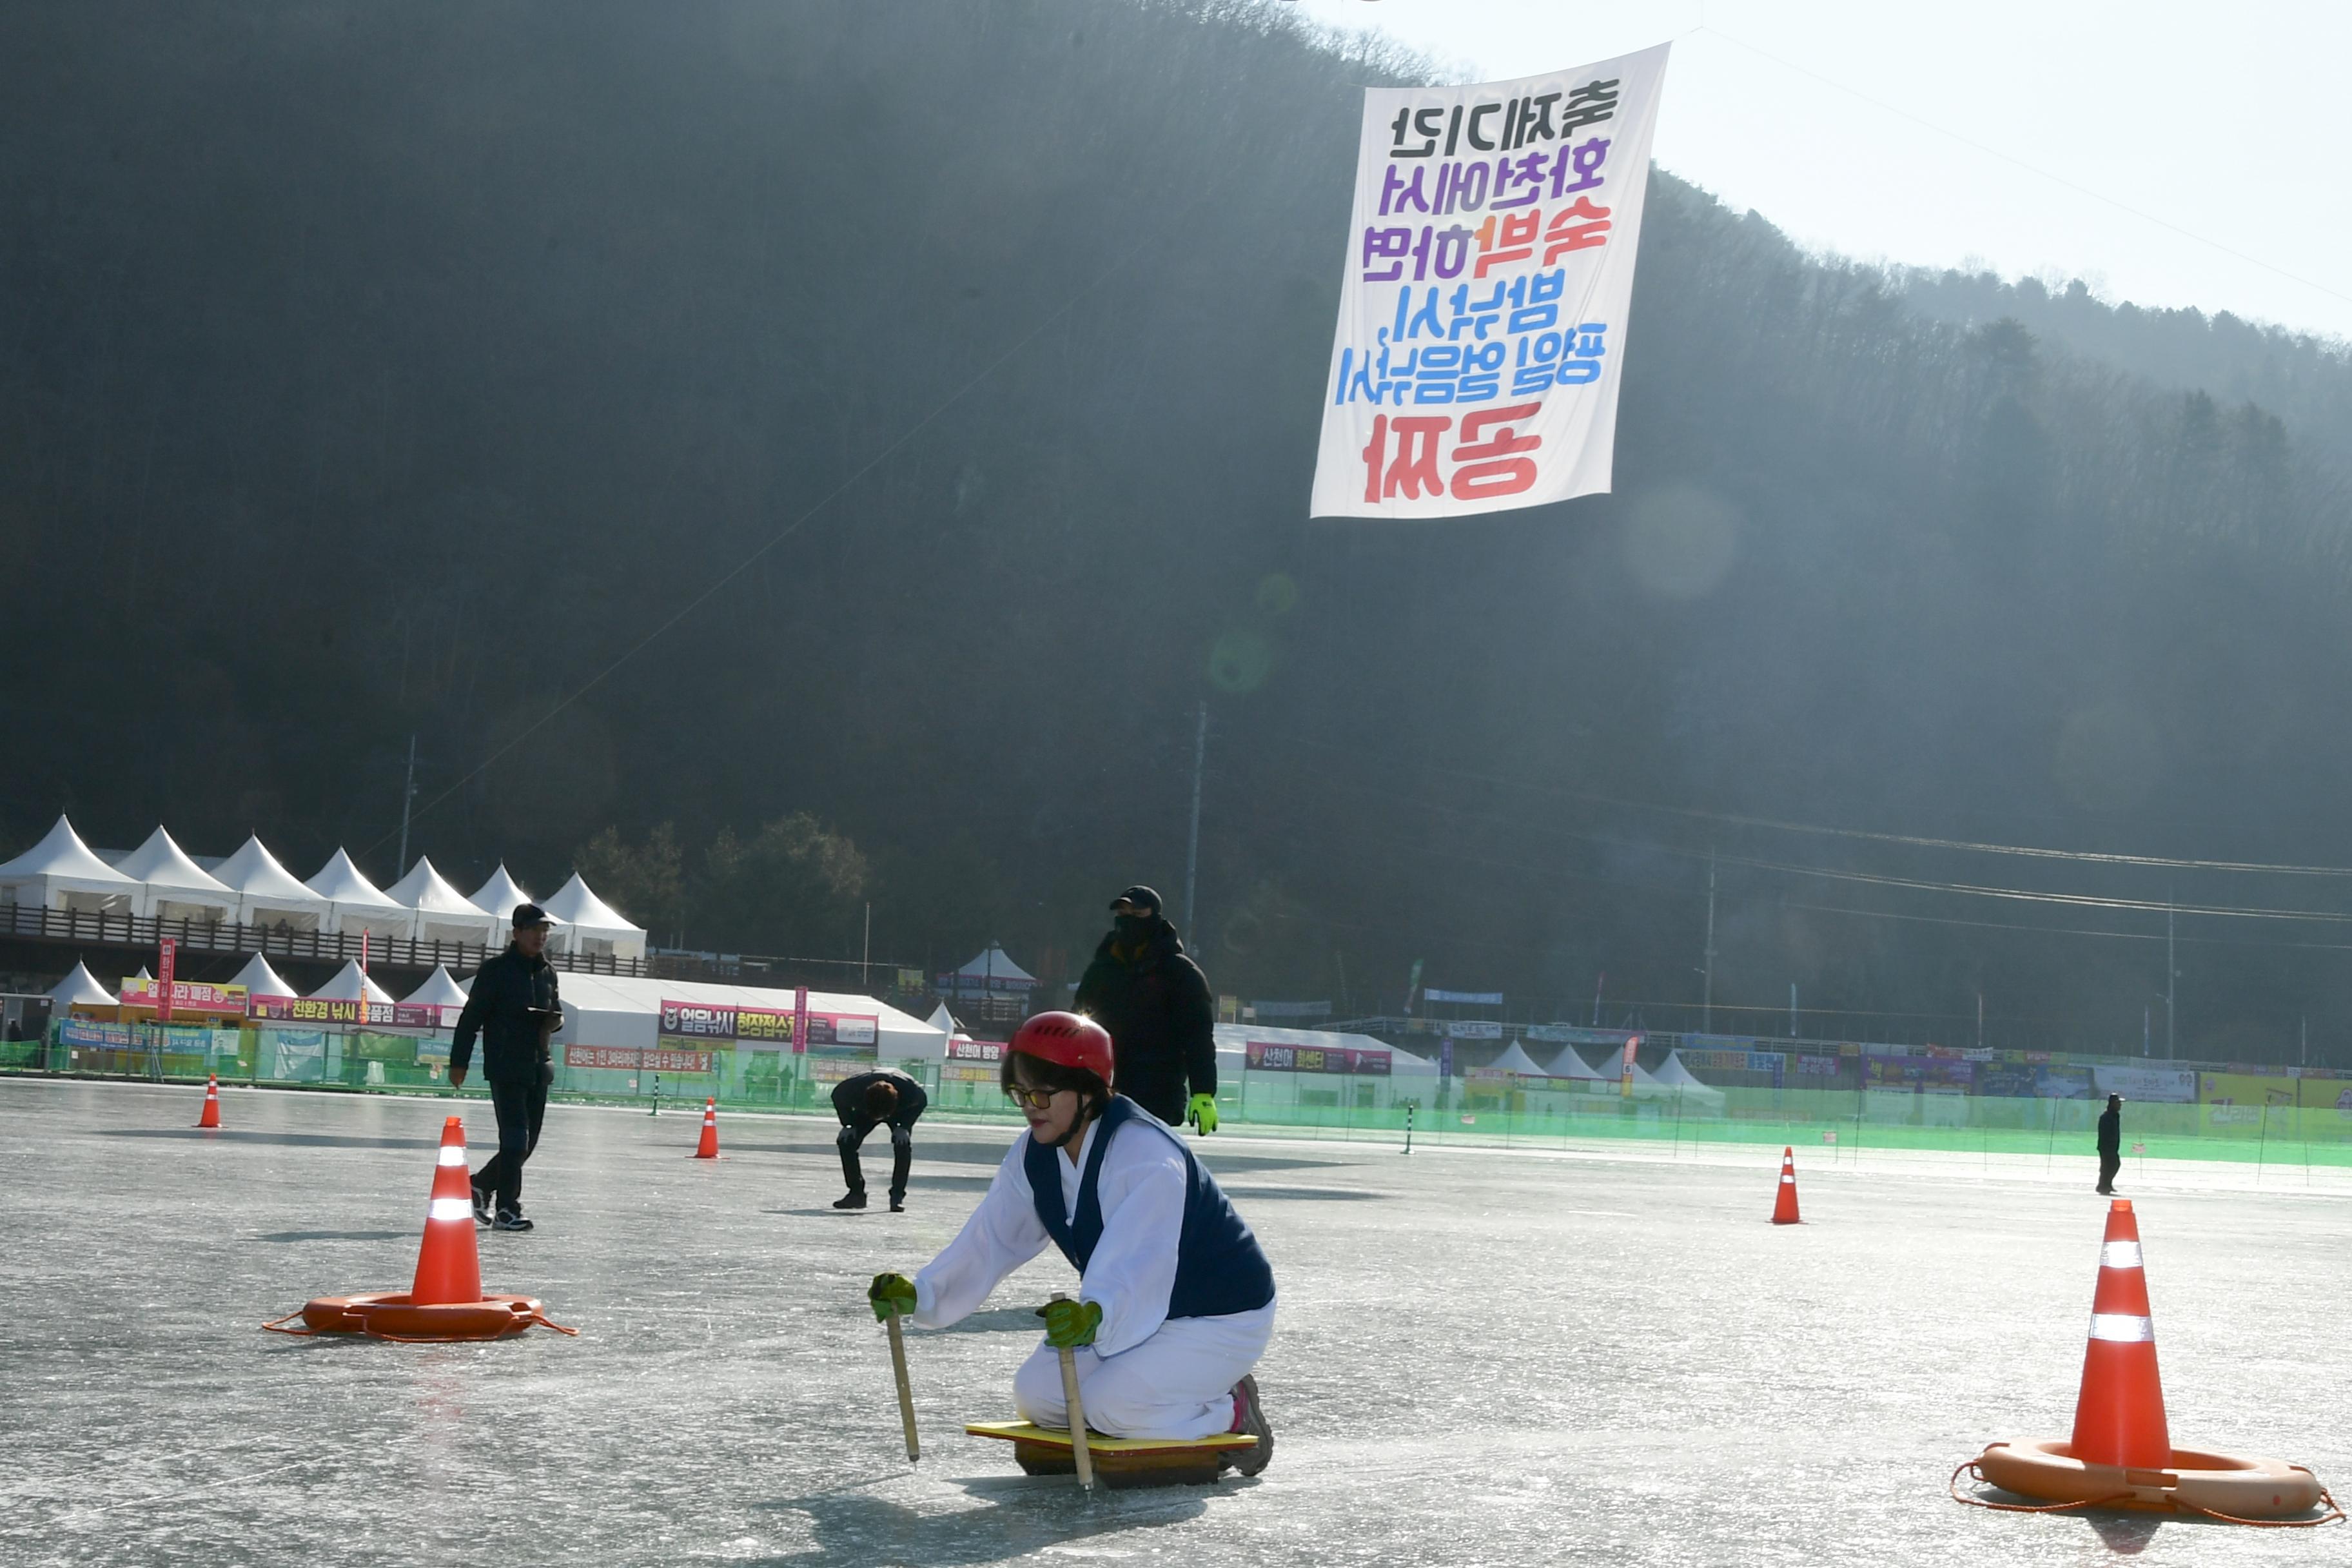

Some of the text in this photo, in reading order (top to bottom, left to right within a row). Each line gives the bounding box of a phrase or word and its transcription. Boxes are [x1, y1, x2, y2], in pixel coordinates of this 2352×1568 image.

[148, 983, 188, 1000] 얼나라
[292, 1000, 328, 1019] 친환경
[331, 1001, 355, 1021] 낚시
[681, 1007, 734, 1035] 얼음낚시
[662, 1053, 669, 1068] 수
[957, 1043, 981, 1059] 산천어
[1264, 1047, 1293, 1068] 산천어
[1296, 1050, 1324, 1070] 회센터
